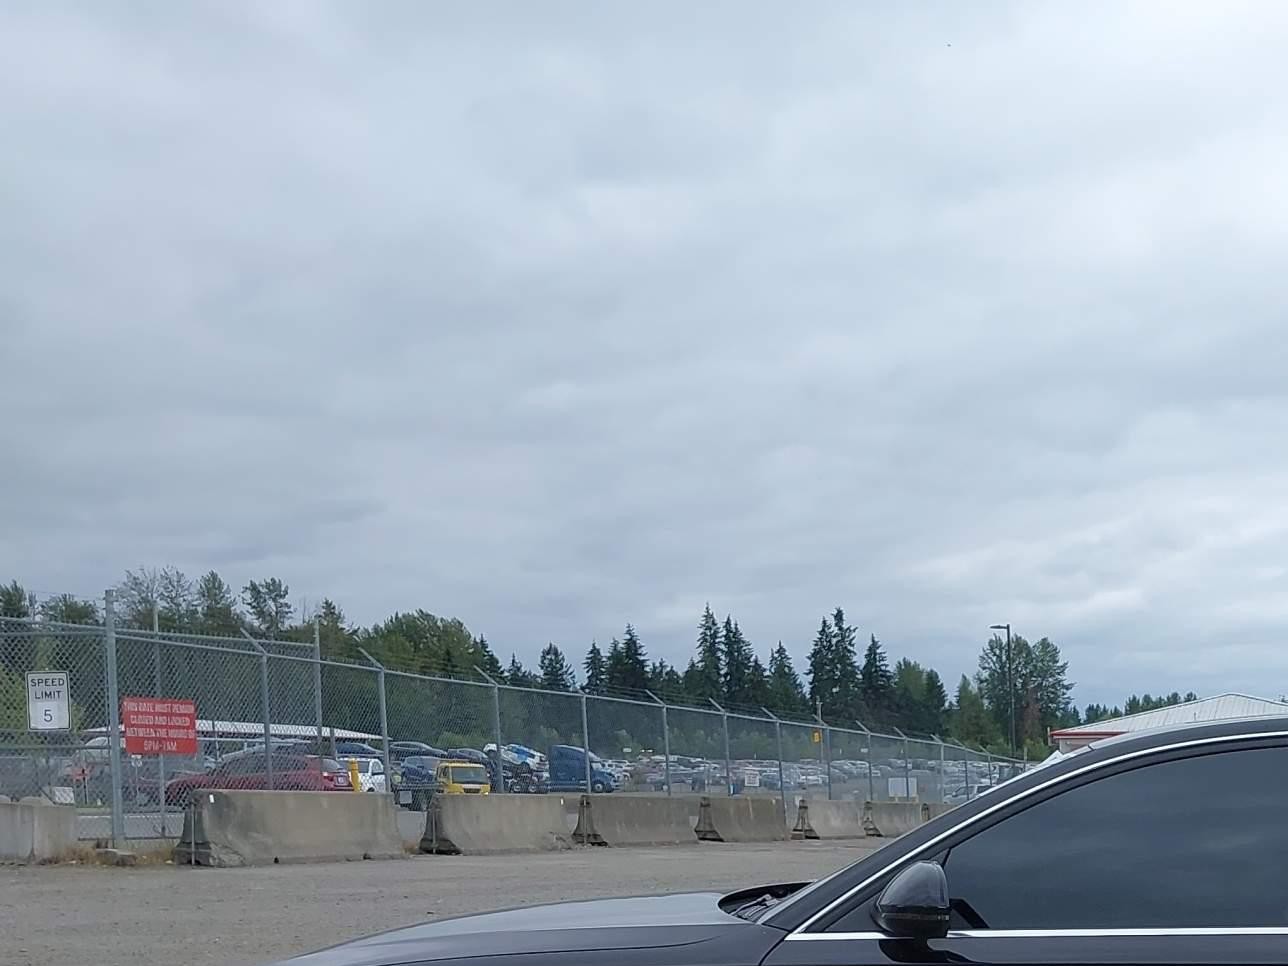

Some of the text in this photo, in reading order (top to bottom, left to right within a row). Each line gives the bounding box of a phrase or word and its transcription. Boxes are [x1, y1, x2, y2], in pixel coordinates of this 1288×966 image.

[30, 678, 65, 687] SPEED
[35, 690, 64, 700] LIMIT
[44, 709, 53, 723] 5
